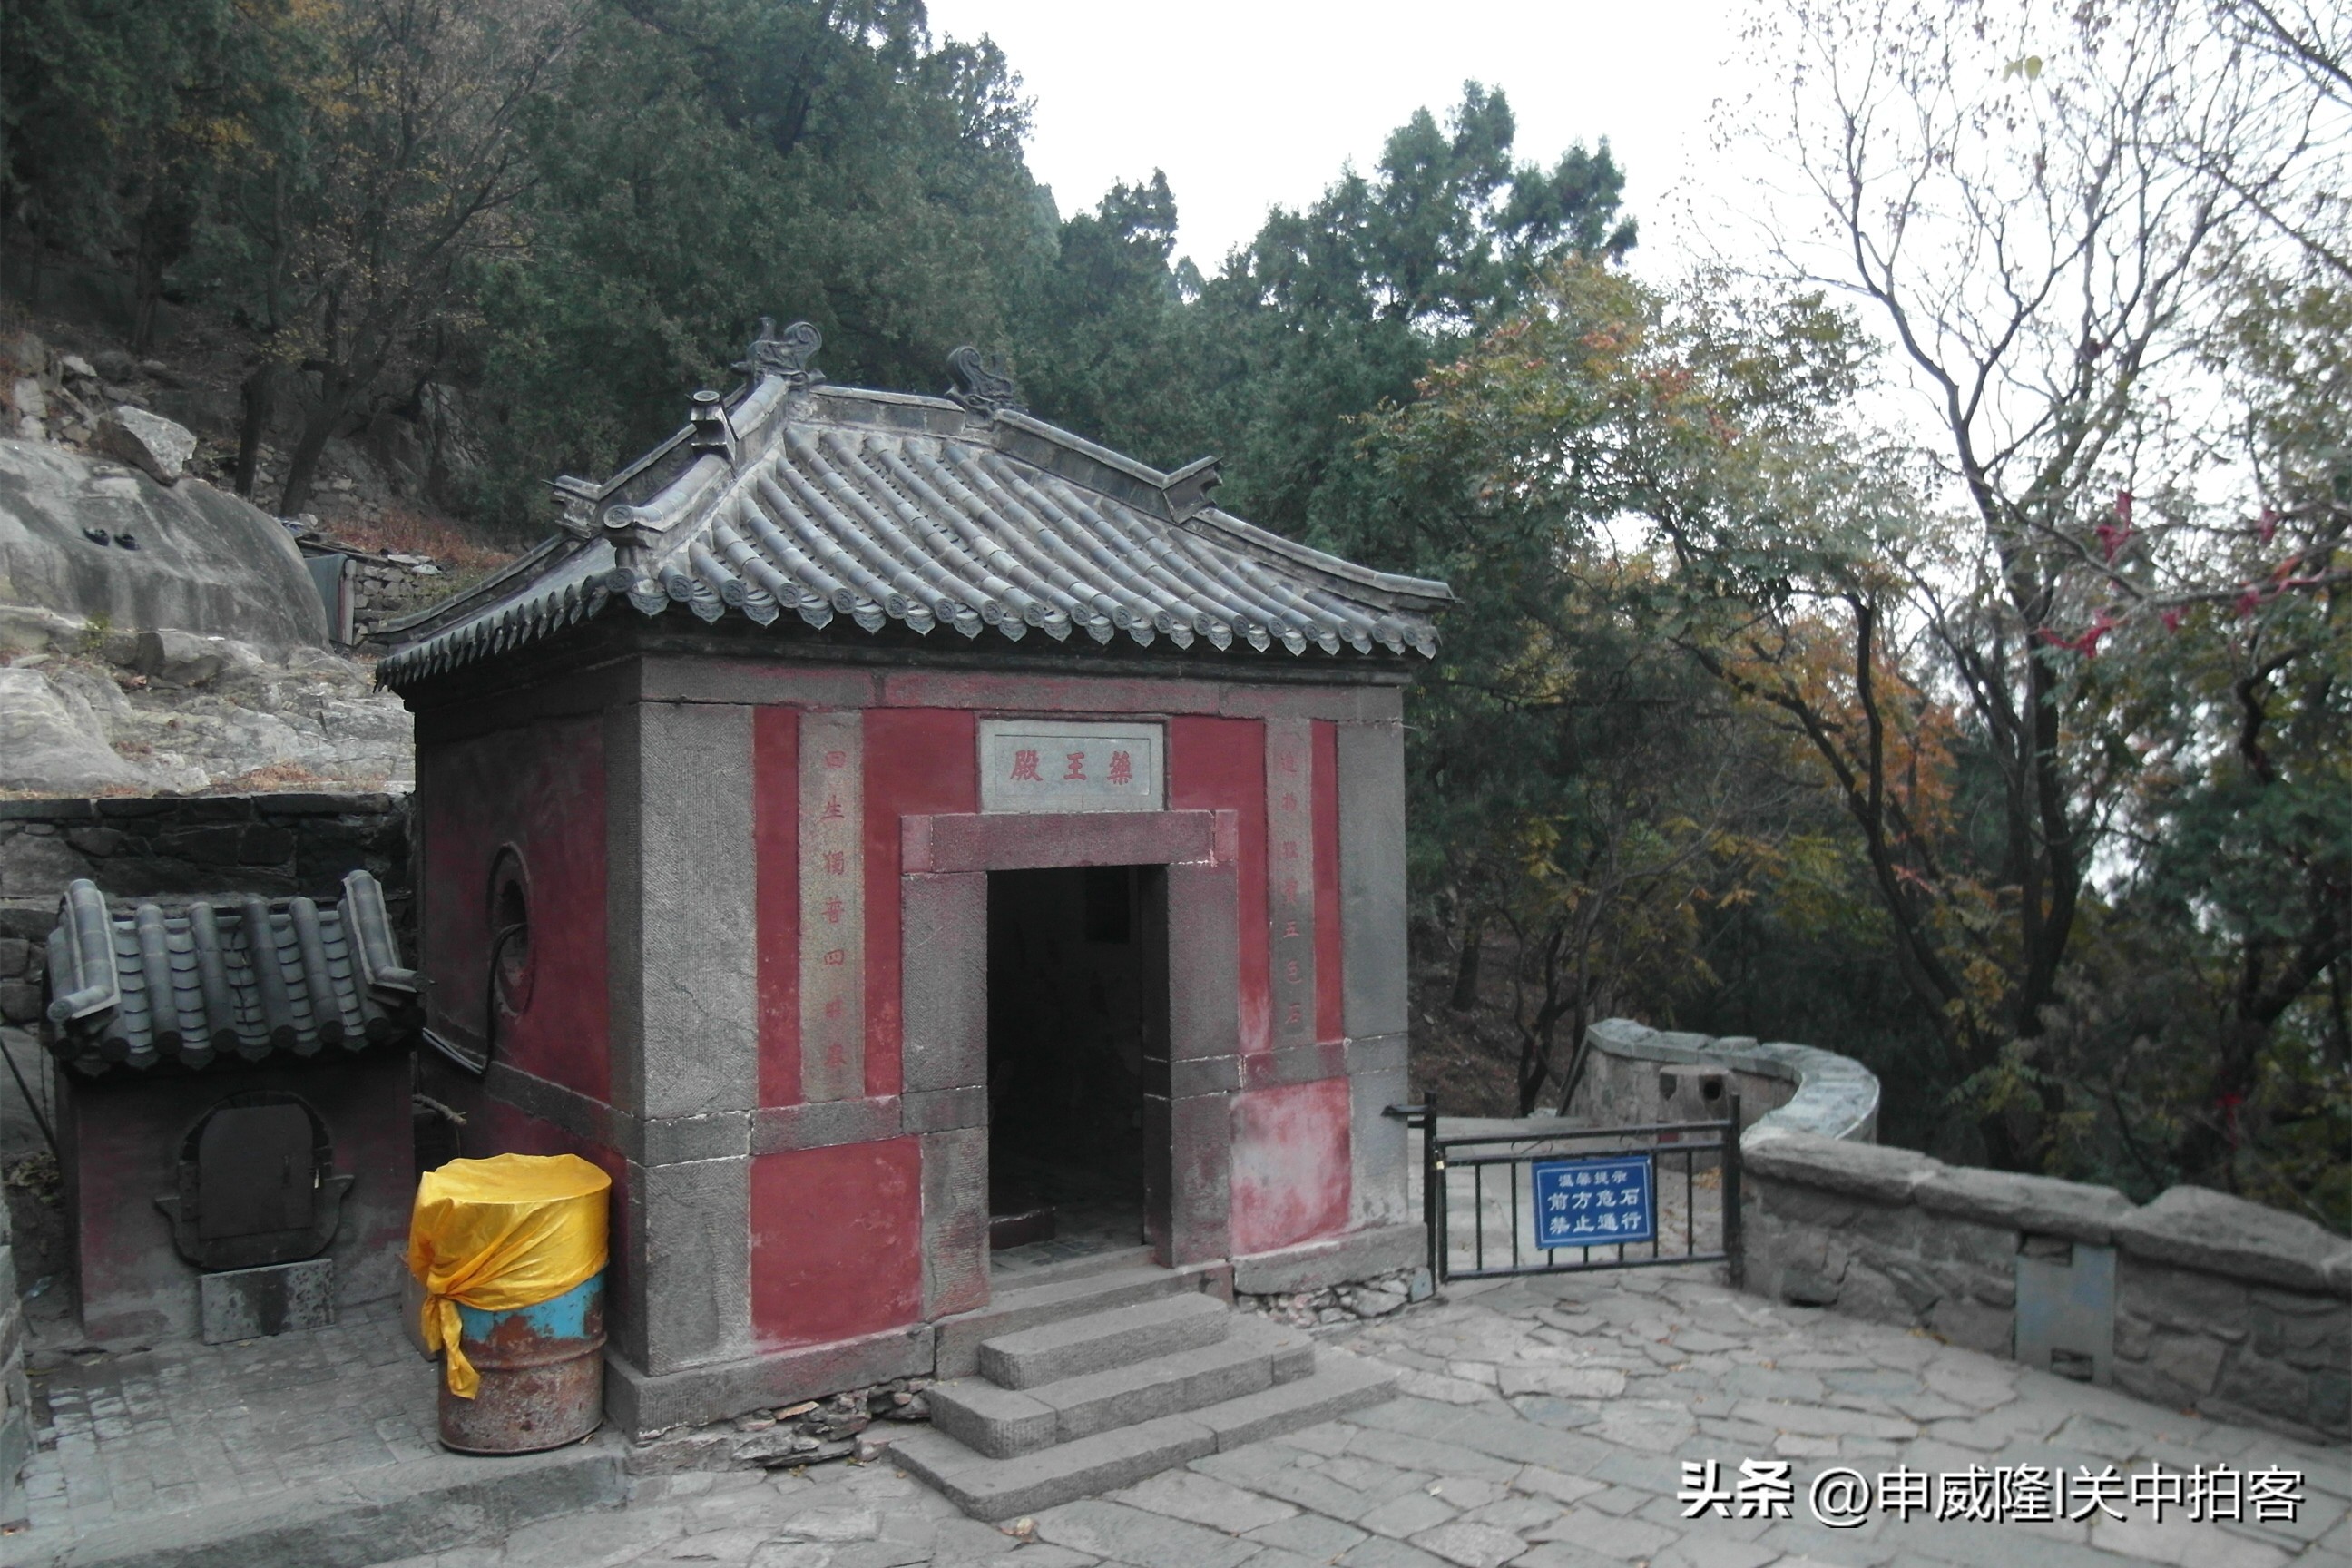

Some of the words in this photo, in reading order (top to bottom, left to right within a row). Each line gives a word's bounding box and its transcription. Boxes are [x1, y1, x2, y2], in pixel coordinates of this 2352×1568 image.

[1547, 1187, 1640, 1211] 前方危石
[1549, 1211, 1642, 1235] 禁止通行
